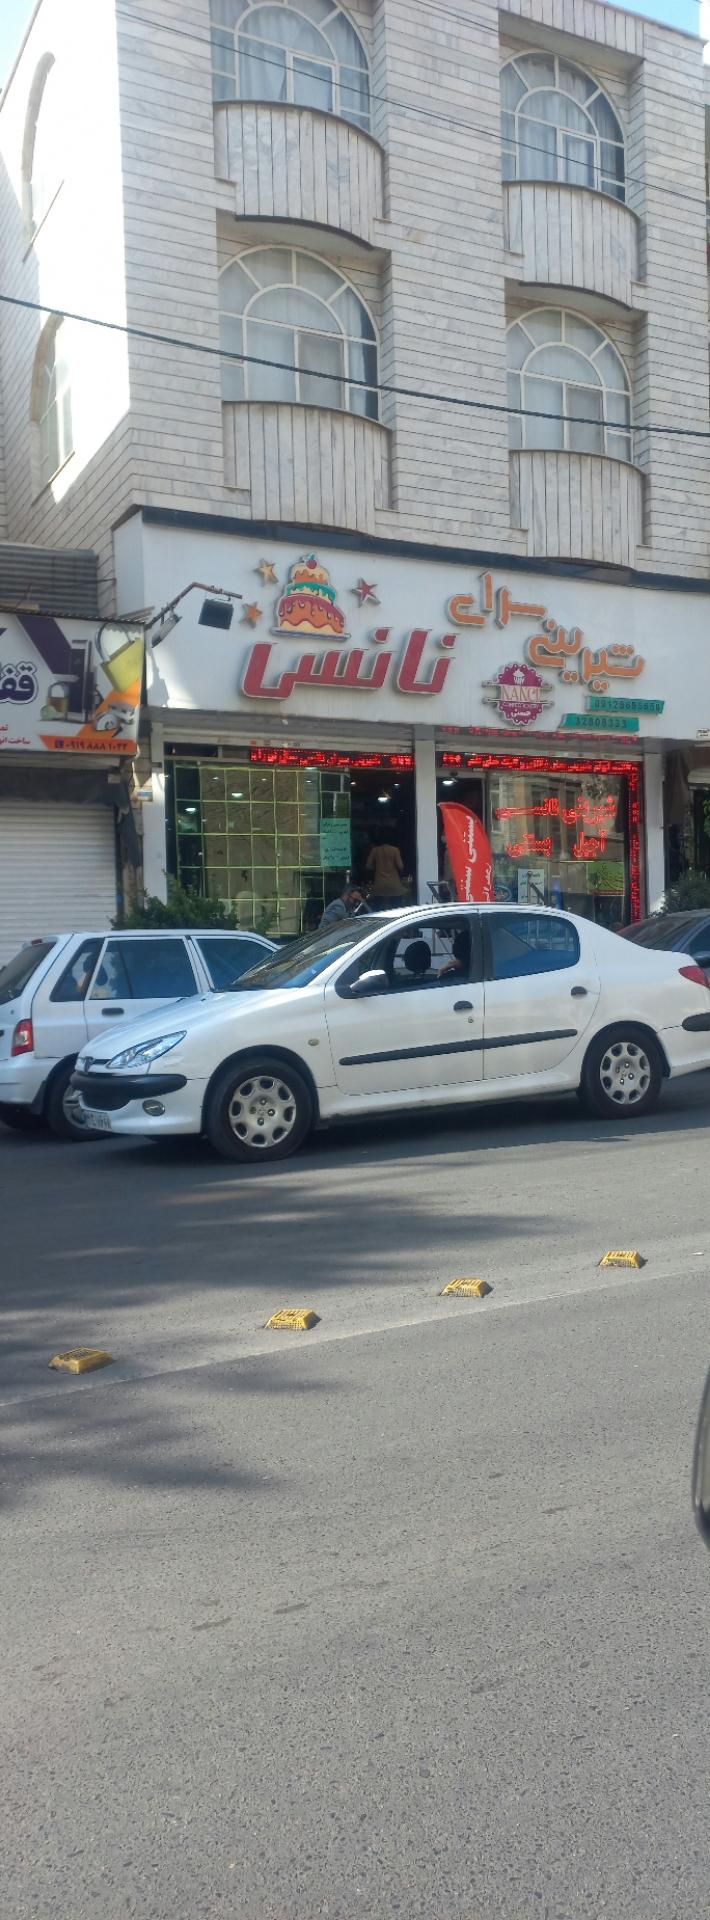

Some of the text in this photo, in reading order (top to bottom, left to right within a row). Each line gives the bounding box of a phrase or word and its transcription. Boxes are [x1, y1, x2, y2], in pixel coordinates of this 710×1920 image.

[242, 627, 458, 699] نانسی
[449, 571, 645, 692] شیرینی سرای
[0, 662, 37, 703] قف
